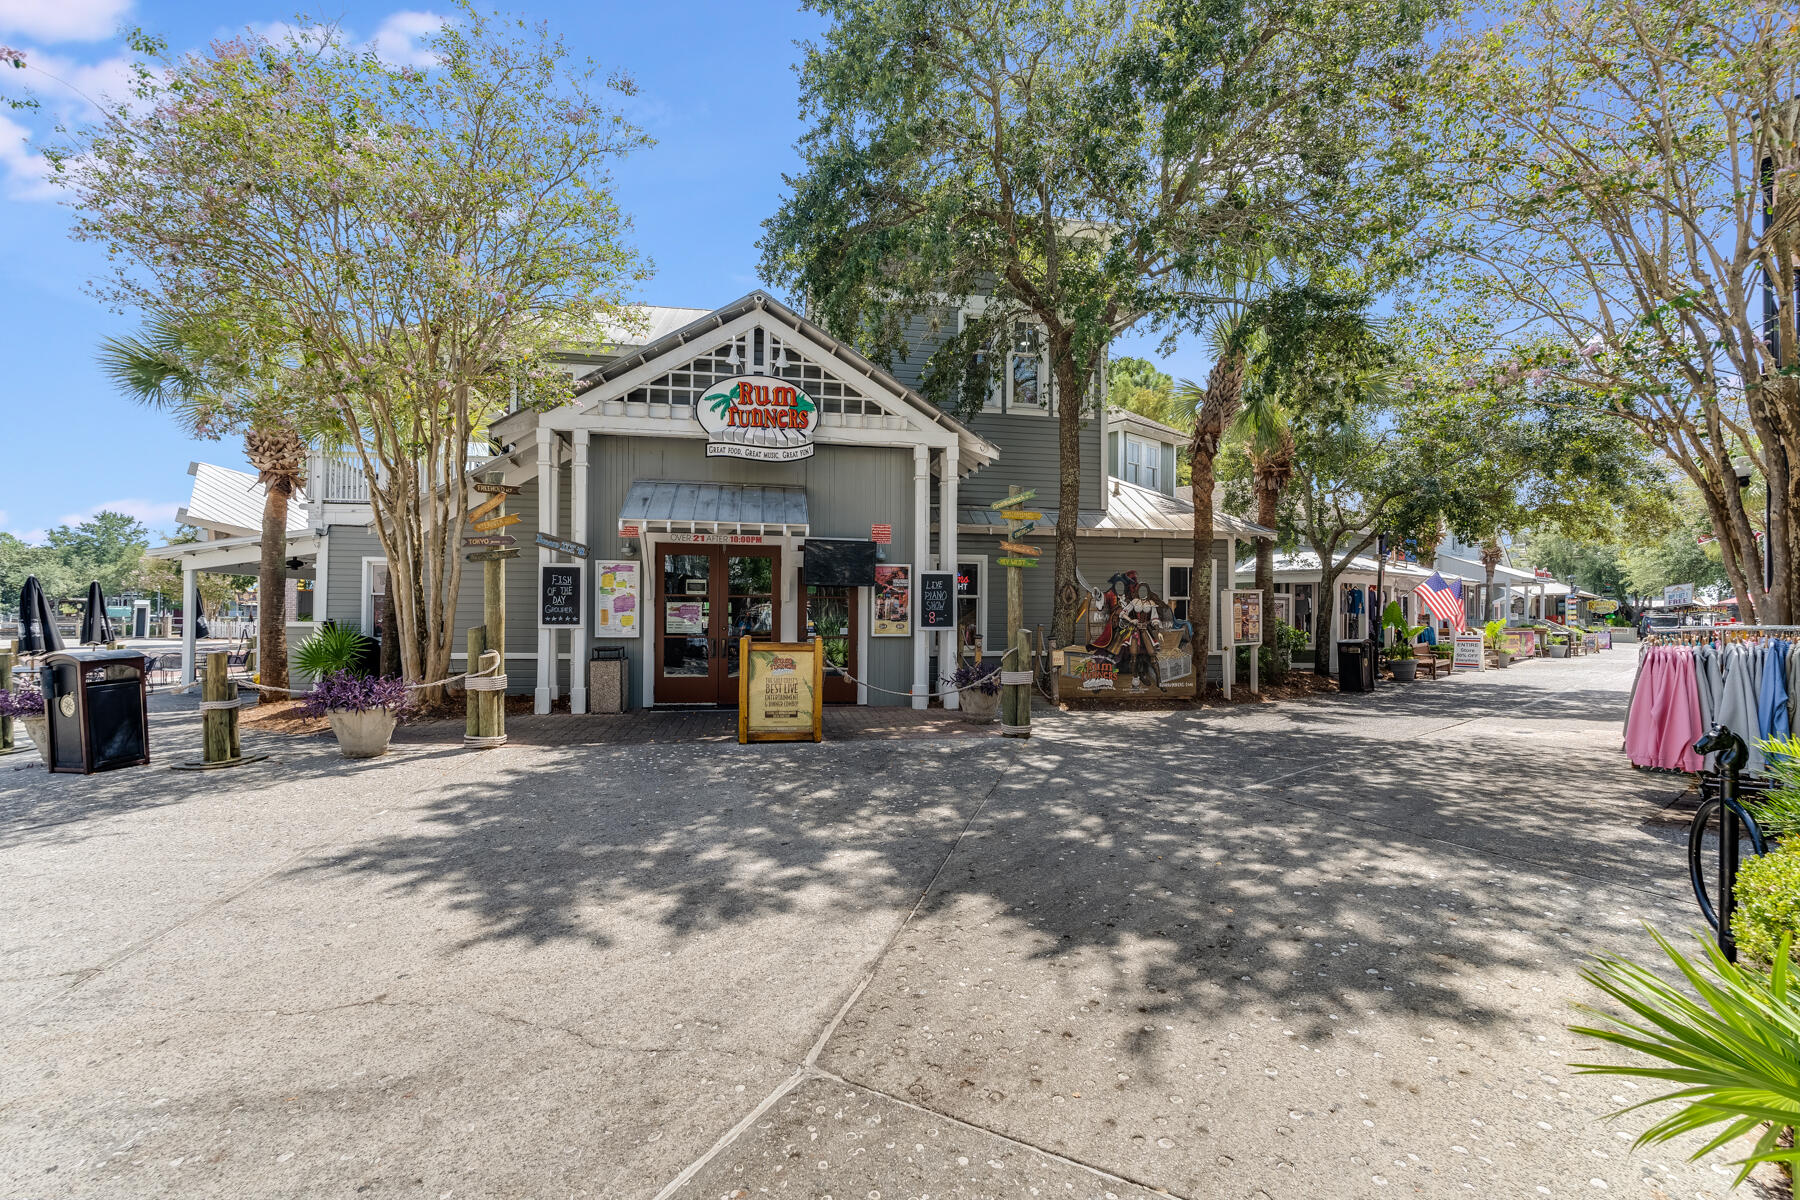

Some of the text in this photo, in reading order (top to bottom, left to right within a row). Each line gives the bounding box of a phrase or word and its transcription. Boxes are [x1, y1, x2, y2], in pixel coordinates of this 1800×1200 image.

[708, 446, 726, 454] GREAT
[744, 448, 762, 457] GREAT
[782, 451, 798, 459] GREAT
[670, 534, 692, 542] OVER
[552, 574, 572, 584] FISH
[926, 580, 943, 589] LIVE
[547, 586, 572, 595] OF THE
[924, 591, 948, 600] PIANO
[552, 596, 566, 605] DAY
[926, 602, 945, 610] SHOW
[929, 612, 936, 623] 8
[766, 683, 798, 694] BEST LIVE
